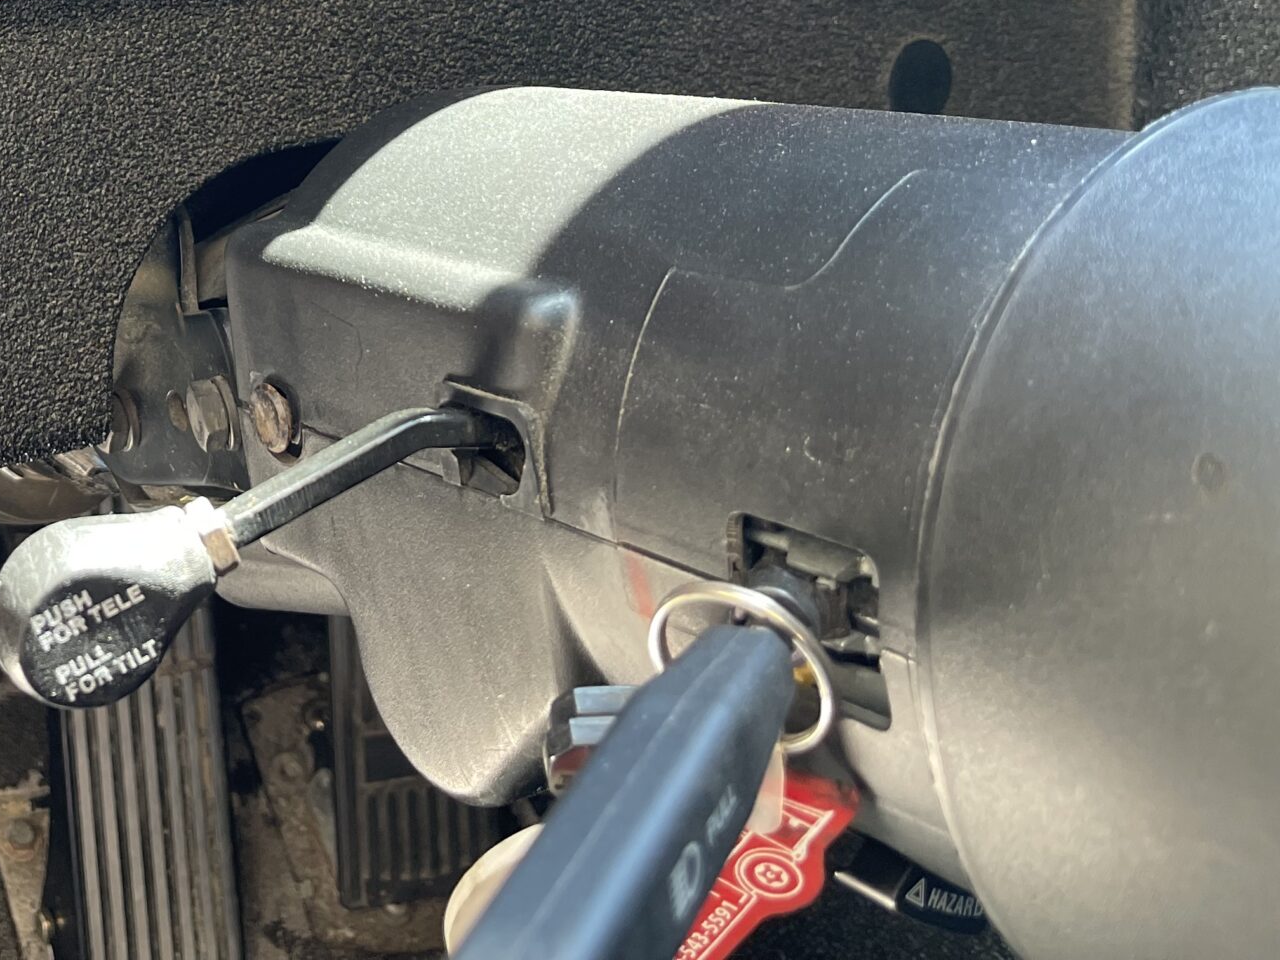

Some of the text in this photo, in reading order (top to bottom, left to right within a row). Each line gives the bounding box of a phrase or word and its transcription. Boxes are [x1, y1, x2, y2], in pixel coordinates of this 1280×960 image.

[30, 589, 93, 635] PUSH
[37, 584, 145, 652] FOR TELE
[54, 645, 113, 685] PULL
[64, 638, 159, 702] FOR TILT
[928, 887, 984, 917] HAZARD
